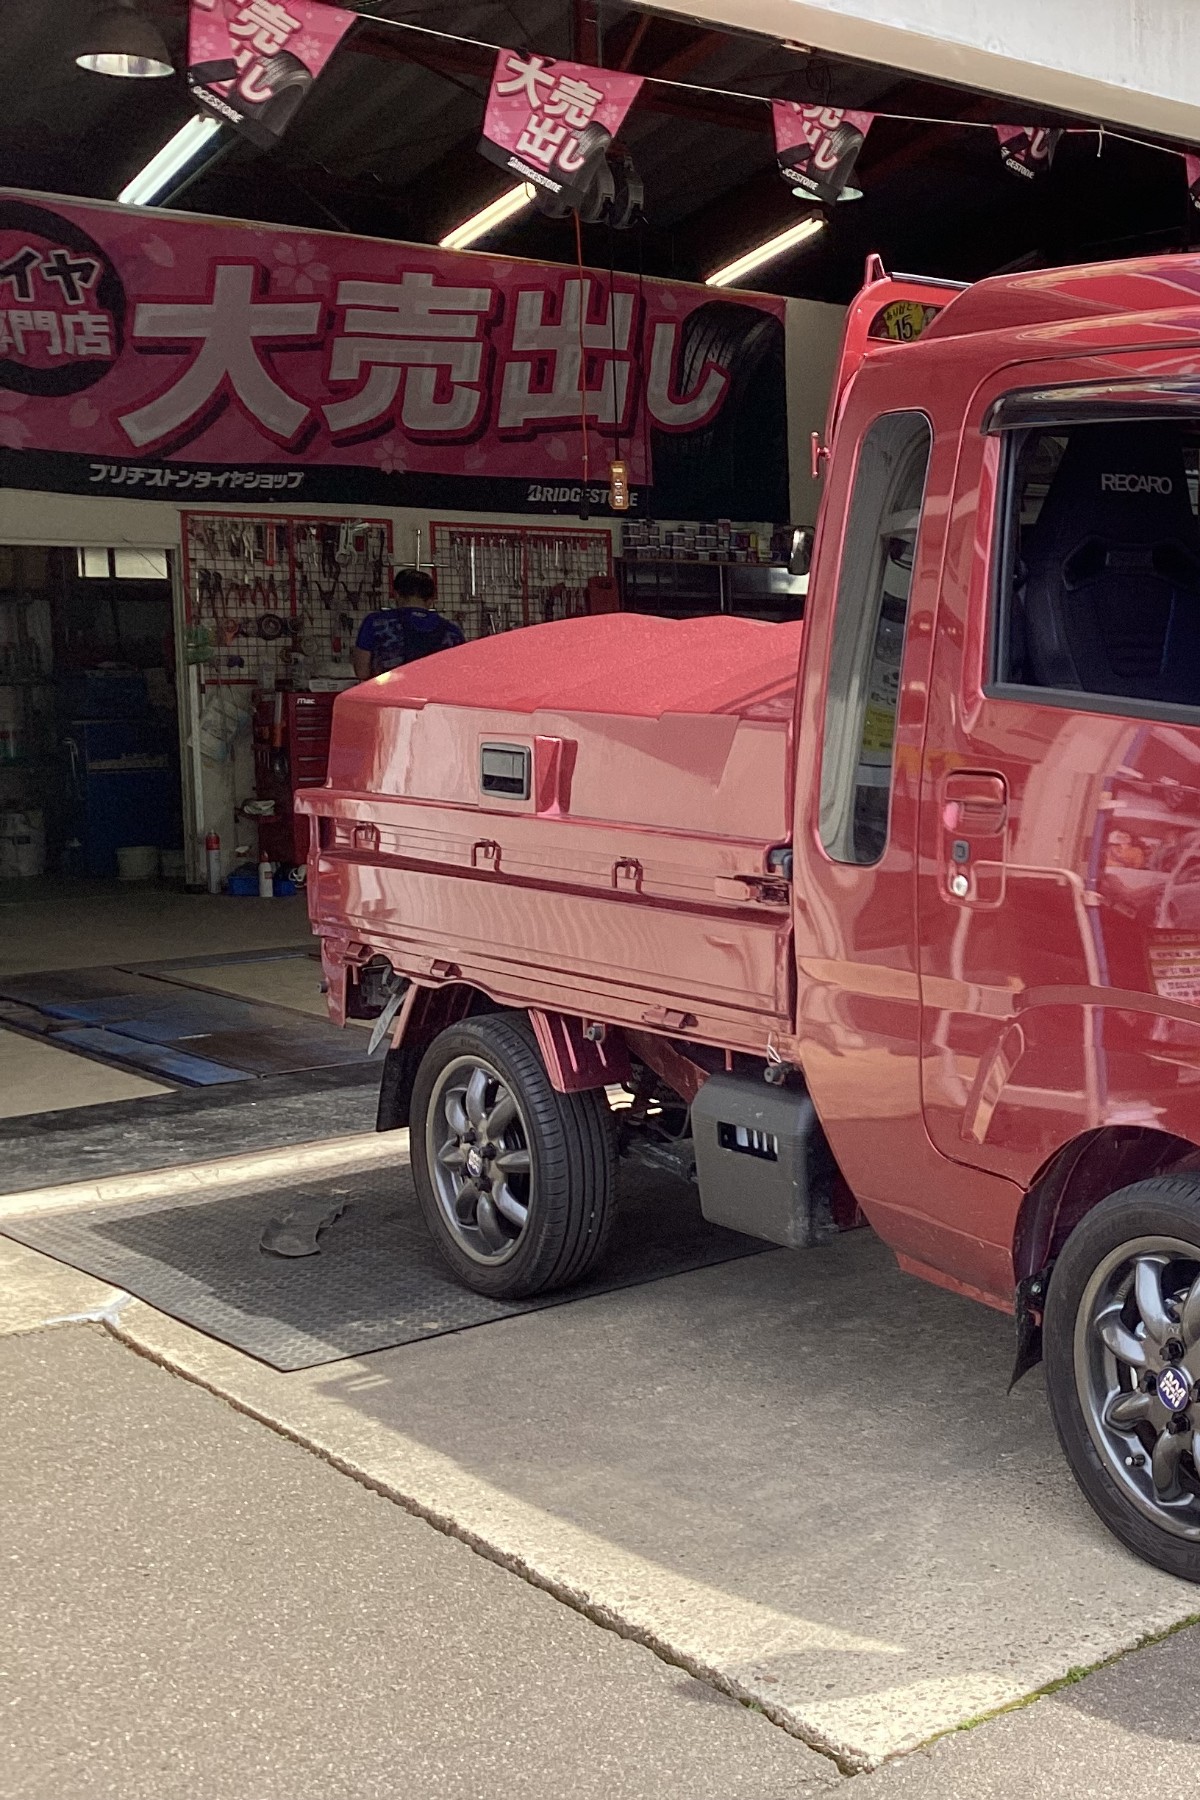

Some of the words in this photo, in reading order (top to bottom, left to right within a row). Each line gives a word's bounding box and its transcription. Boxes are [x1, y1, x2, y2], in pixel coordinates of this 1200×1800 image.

[496, 57, 604, 127] 大売
[516, 114, 585, 171] 出し
[118, 264, 730, 448] 大売出し
[1101, 473, 1173, 495] RECARO
